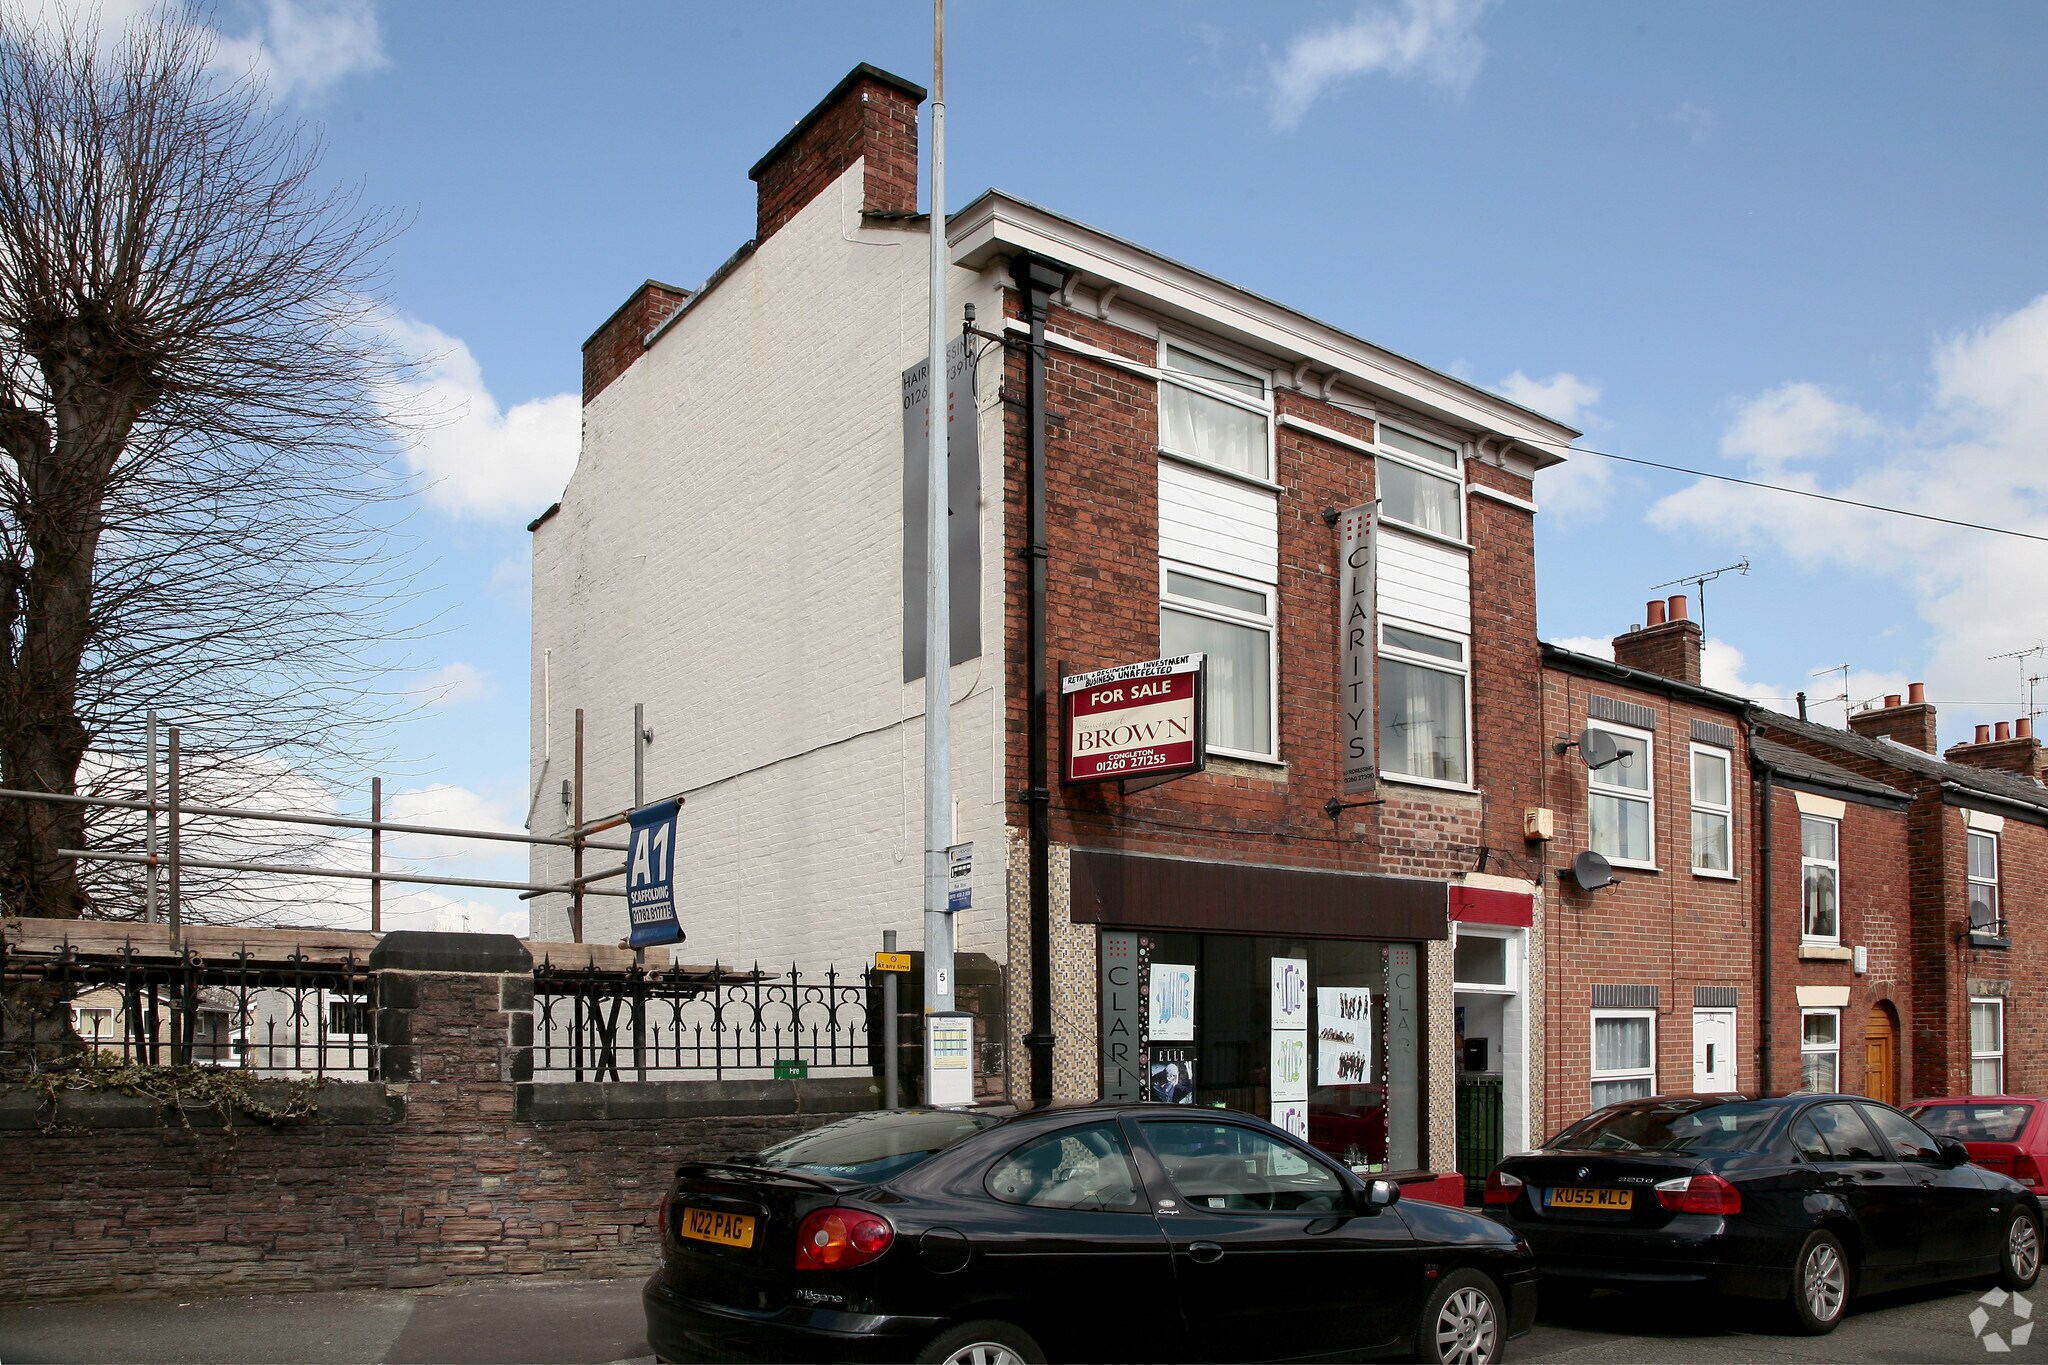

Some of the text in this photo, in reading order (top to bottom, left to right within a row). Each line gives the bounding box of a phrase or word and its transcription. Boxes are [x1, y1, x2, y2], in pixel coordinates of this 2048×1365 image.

[1143, 655, 1190, 669] INVESTMENT
[1347, 546, 1369, 759] CLARITYS
[1085, 666, 1173, 688] BUSINESS UNAFFECTED
[1091, 680, 1172, 706] FOR SALE
[1077, 716, 1190, 751] BROWN
[1096, 753, 1166, 772] 01260 271255
[1108, 749, 1154, 761] CONGLETON
[630, 822, 670, 888] A1
[631, 885, 669, 905] SCAFFOLDING
[1159, 1050, 1185, 1062] ELLE
[1555, 1187, 1629, 1206] KU55 WLC
[690, 1211, 743, 1240] N22 PAG
